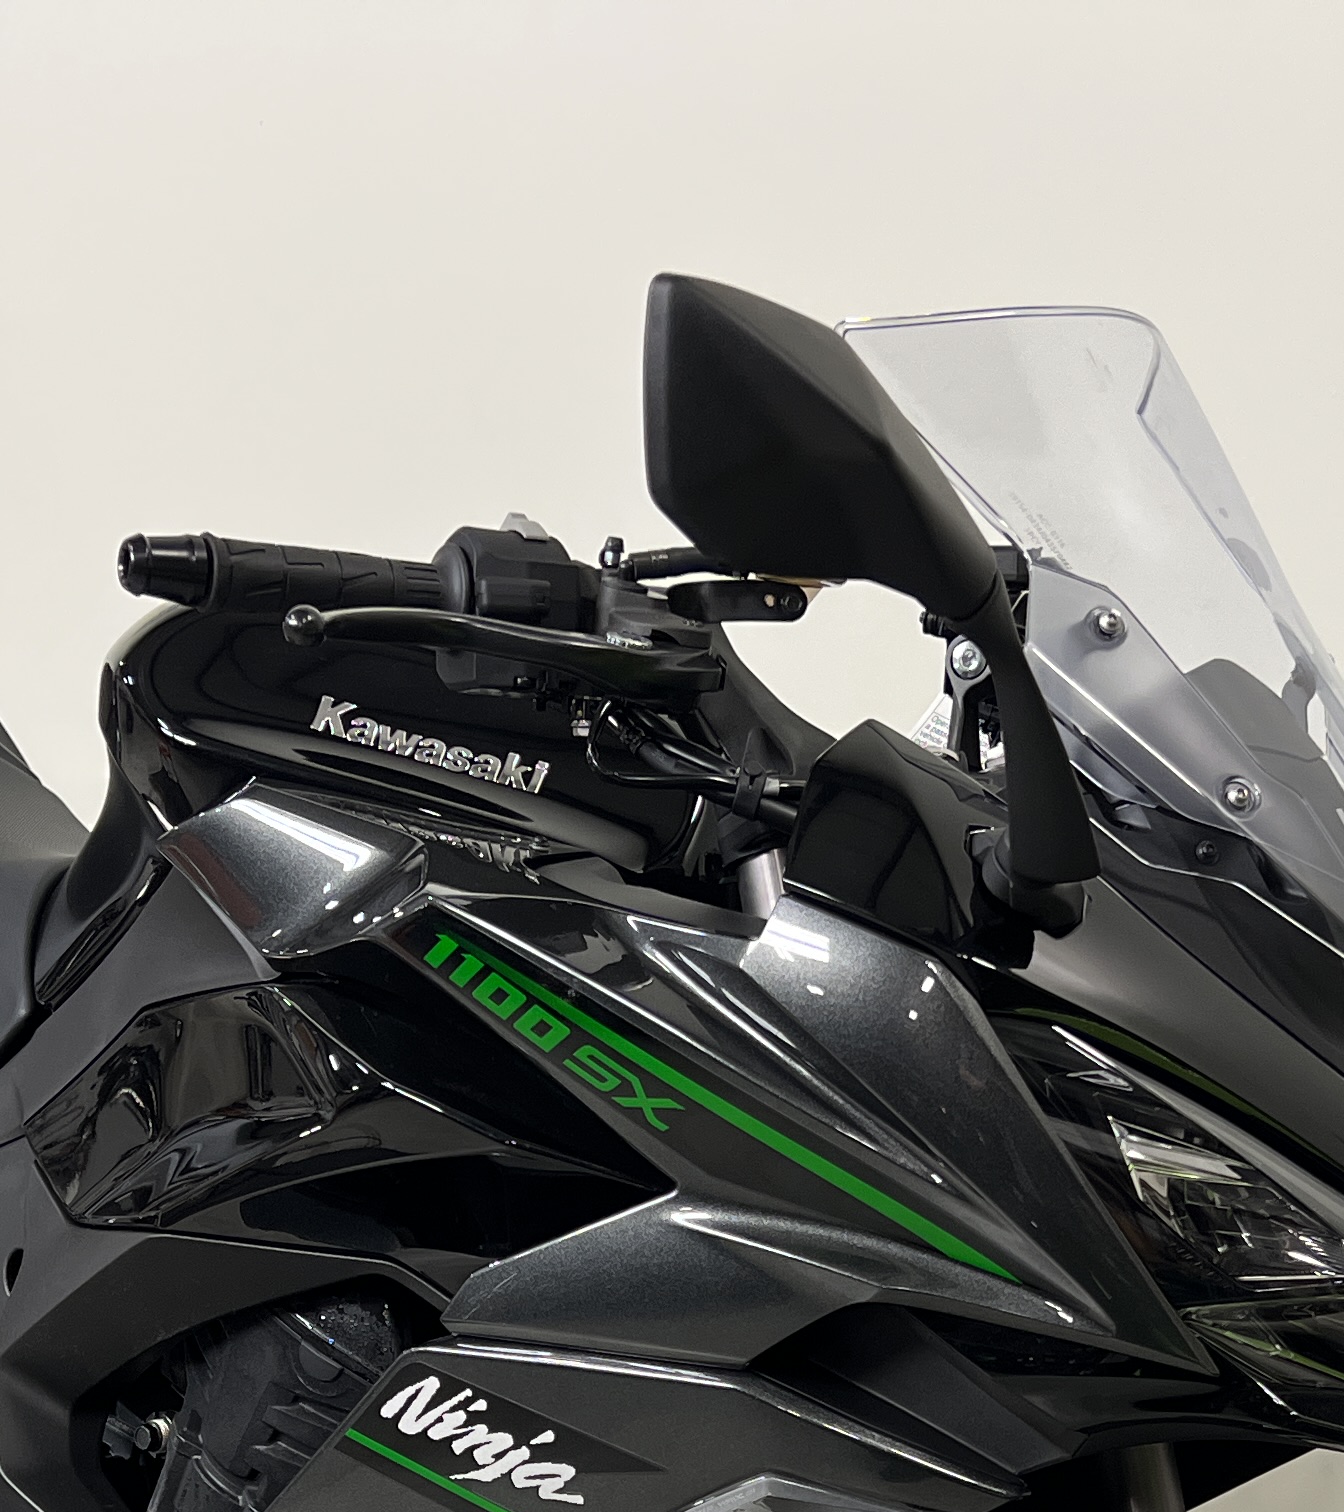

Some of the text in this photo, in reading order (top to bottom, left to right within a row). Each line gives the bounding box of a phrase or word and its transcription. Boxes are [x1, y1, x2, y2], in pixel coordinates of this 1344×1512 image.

[310, 695, 550, 794] Kawasaki
[423, 933, 685, 1132] 1100 SX
[380, 1375, 585, 1505] Ninja
